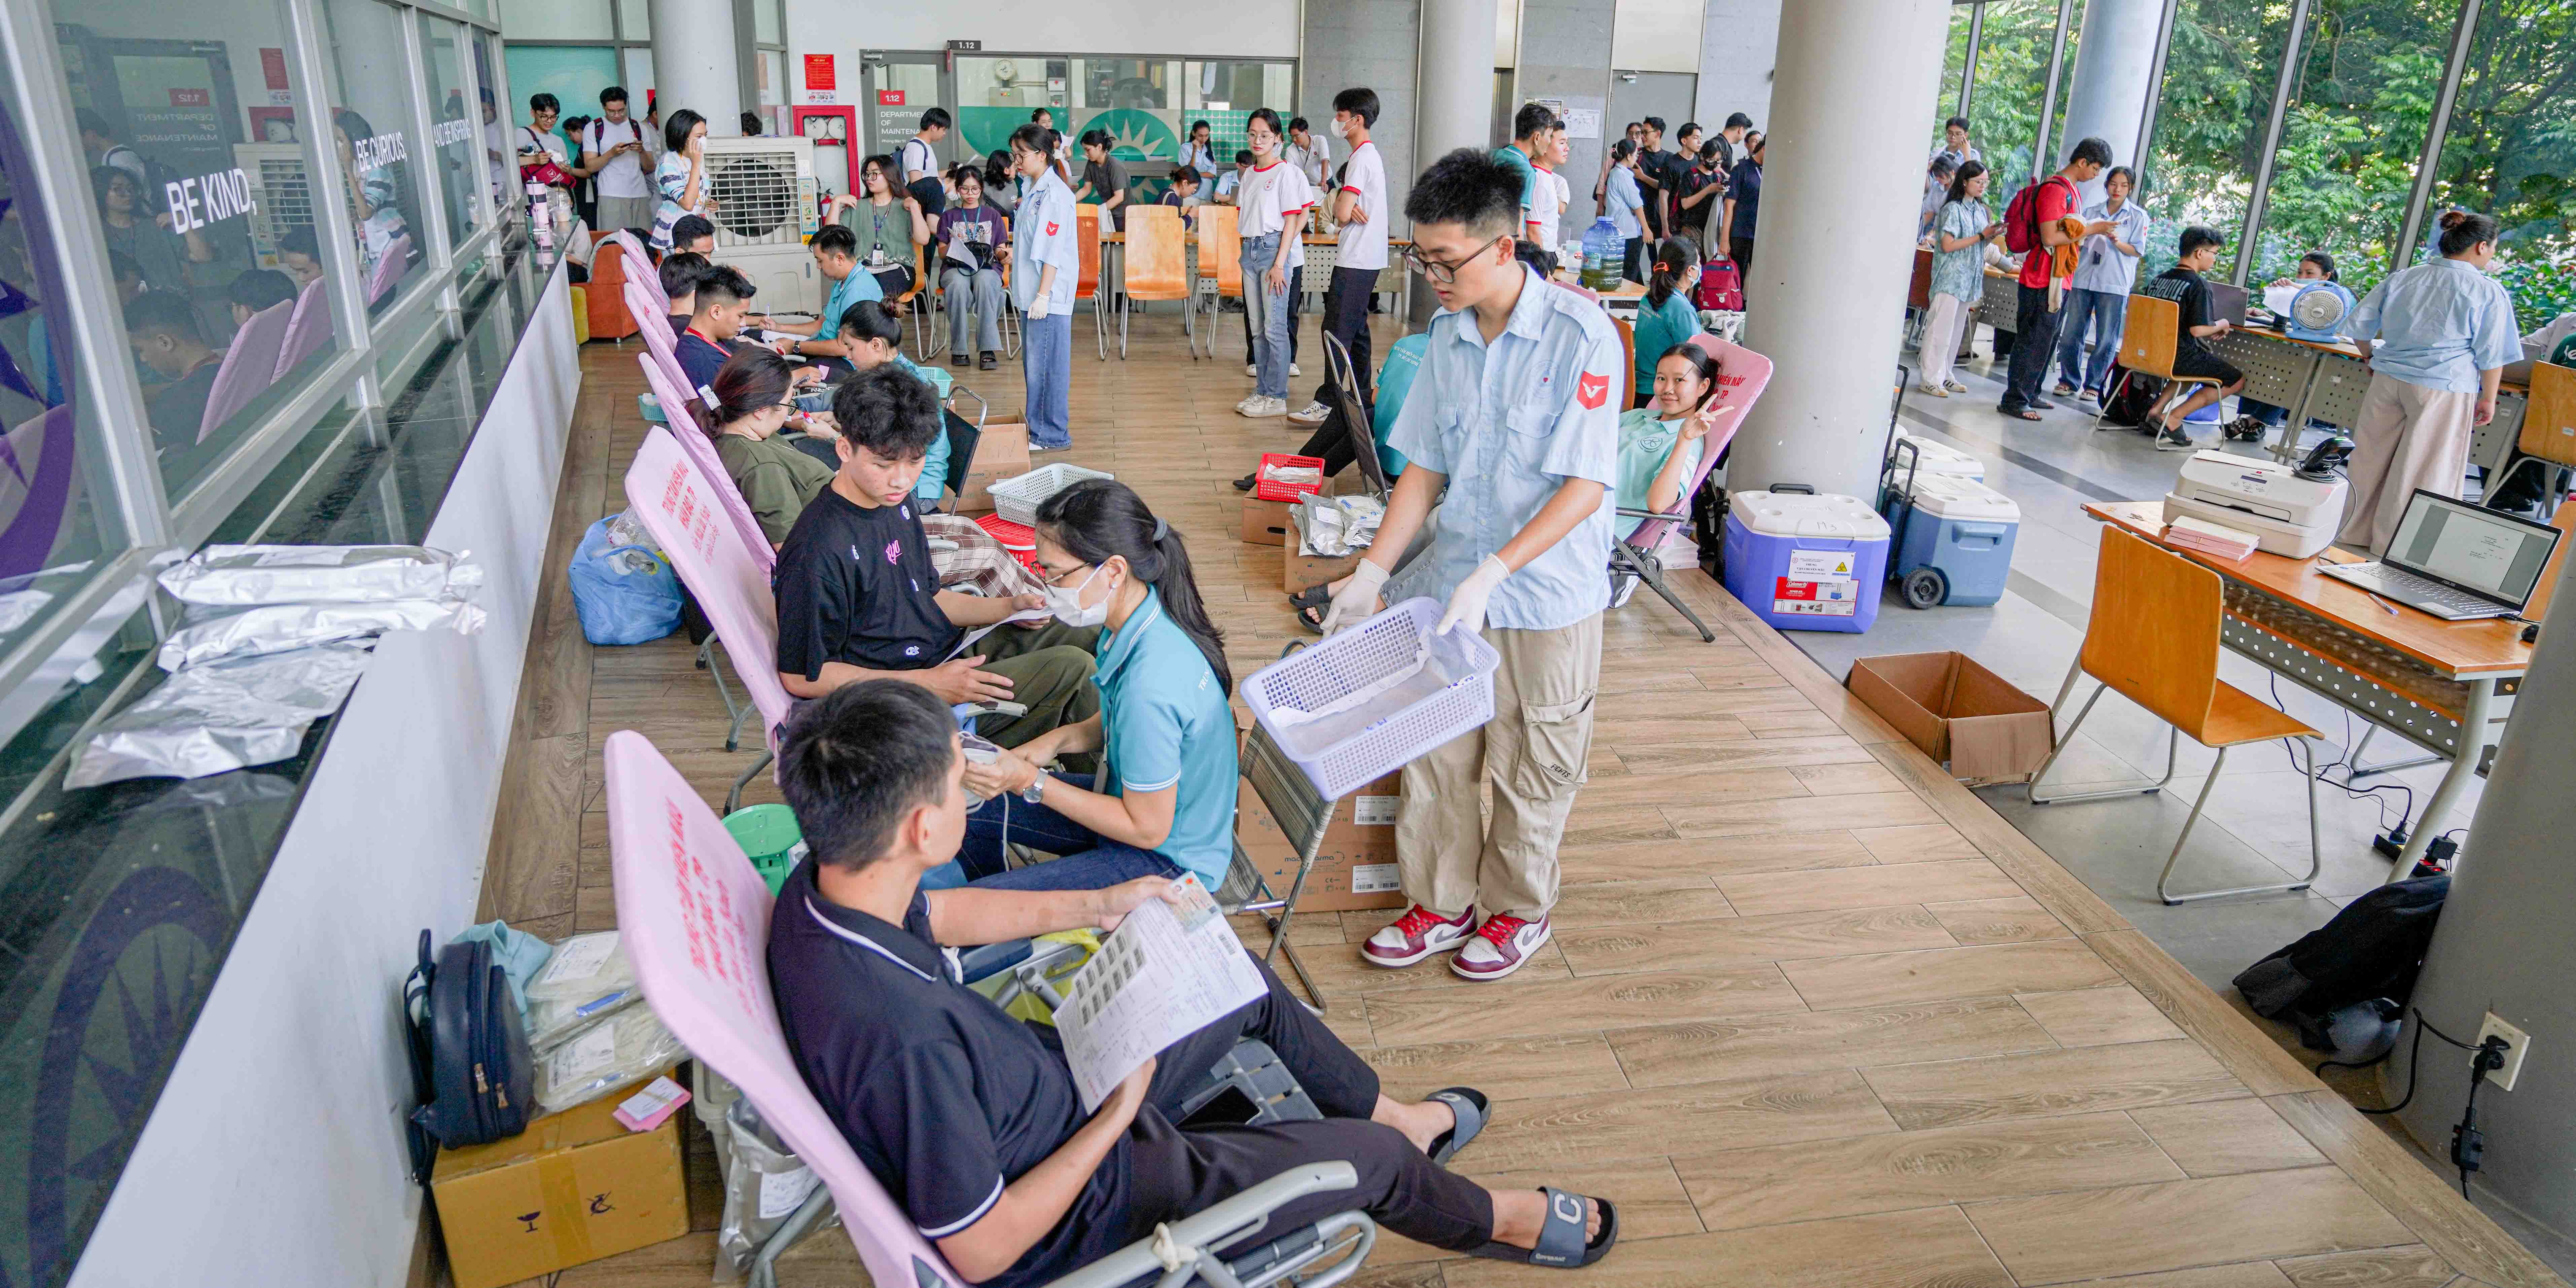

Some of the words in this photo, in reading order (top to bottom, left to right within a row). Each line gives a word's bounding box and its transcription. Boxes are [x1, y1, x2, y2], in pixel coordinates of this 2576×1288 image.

[355, 139, 371, 172] BE
[369, 132, 407, 168] CURIOUS,
[433, 123, 446, 148] AND
[444, 121, 452, 145] BE
[166, 177, 205, 235] BE
[201, 168, 257, 223] KIND,
[1554, 1192, 1582, 1225] C
